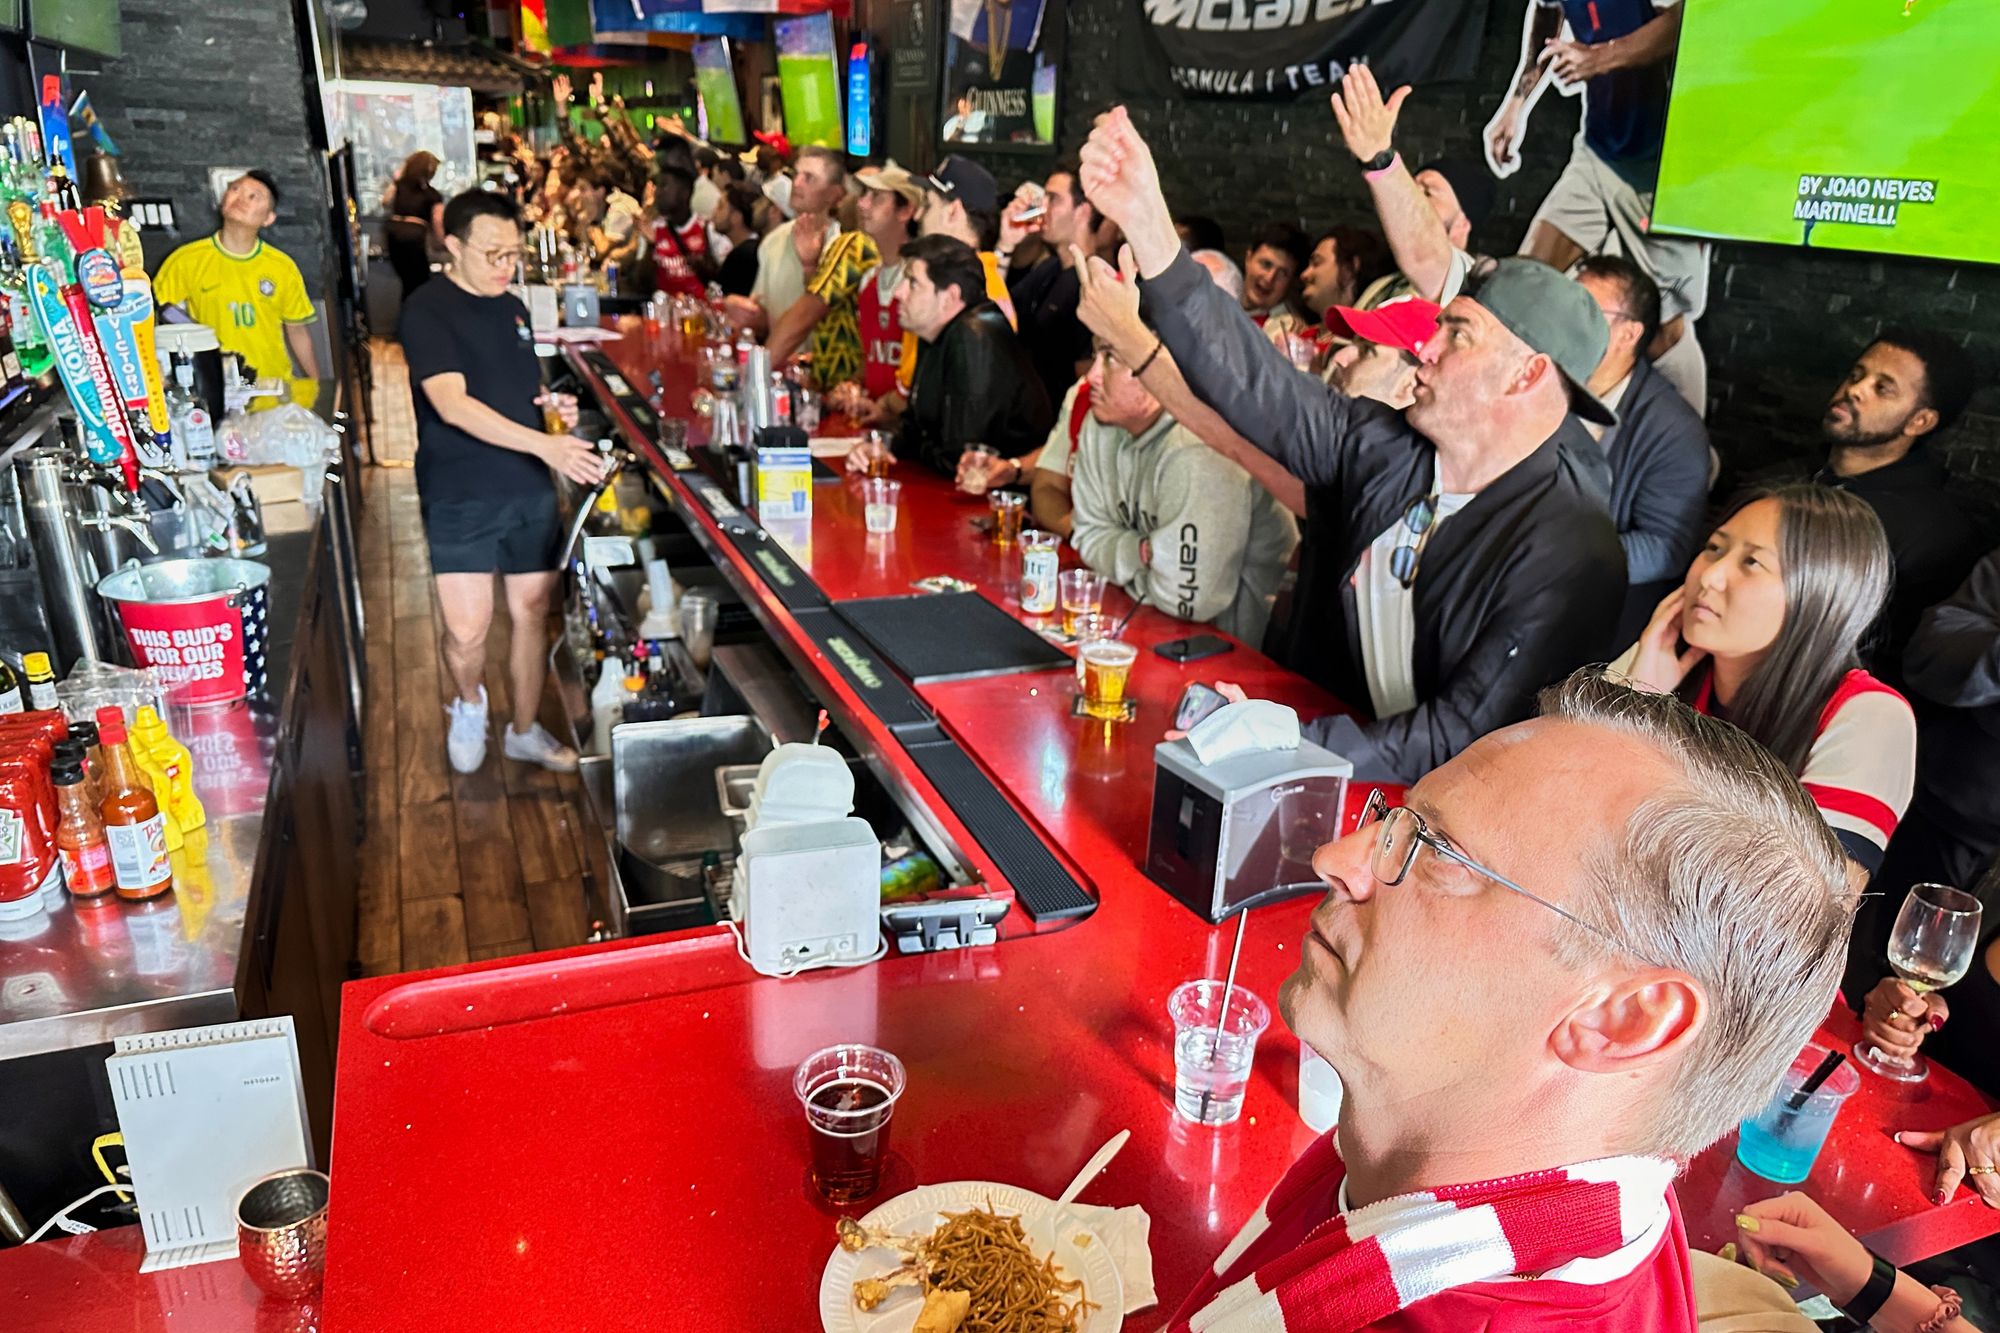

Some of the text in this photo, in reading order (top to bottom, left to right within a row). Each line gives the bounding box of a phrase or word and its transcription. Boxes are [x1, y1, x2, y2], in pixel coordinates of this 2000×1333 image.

[1265, 68, 1275, 92] 1
[966, 86, 1027, 117] GUINNESS
[1799, 176, 1935, 202] BY JOAO NEVES.
[1794, 200, 1896, 225] MARTINELLI.
[228, 301, 256, 327] 10
[53, 320, 91, 385] KONA
[108, 316, 140, 396] VICTORY
[130, 622, 233, 648] THIS BUD'S
[144, 642, 225, 665] FOR OUR
